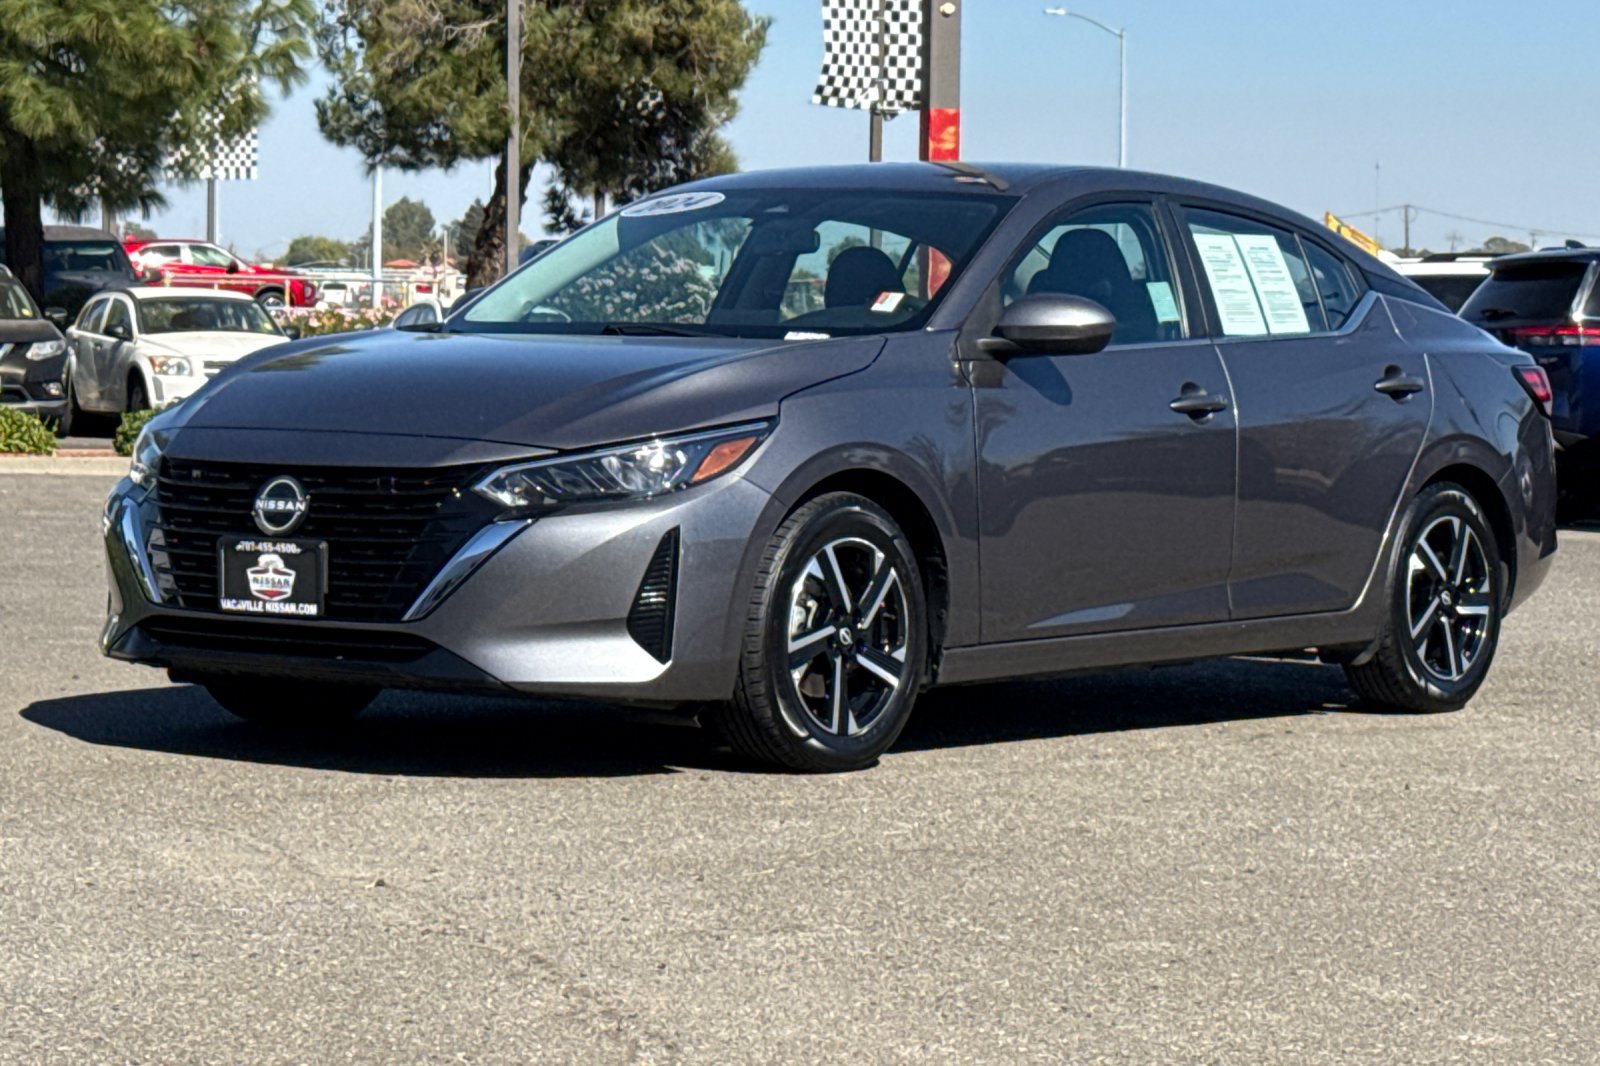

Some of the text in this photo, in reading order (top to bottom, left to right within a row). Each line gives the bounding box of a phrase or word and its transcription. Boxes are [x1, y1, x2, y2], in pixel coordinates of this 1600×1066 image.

[255, 499, 306, 512] NISSAN
[252, 576, 290, 588] NISSAN
[221, 598, 318, 615] VACAVILLE NISSAN.COM
